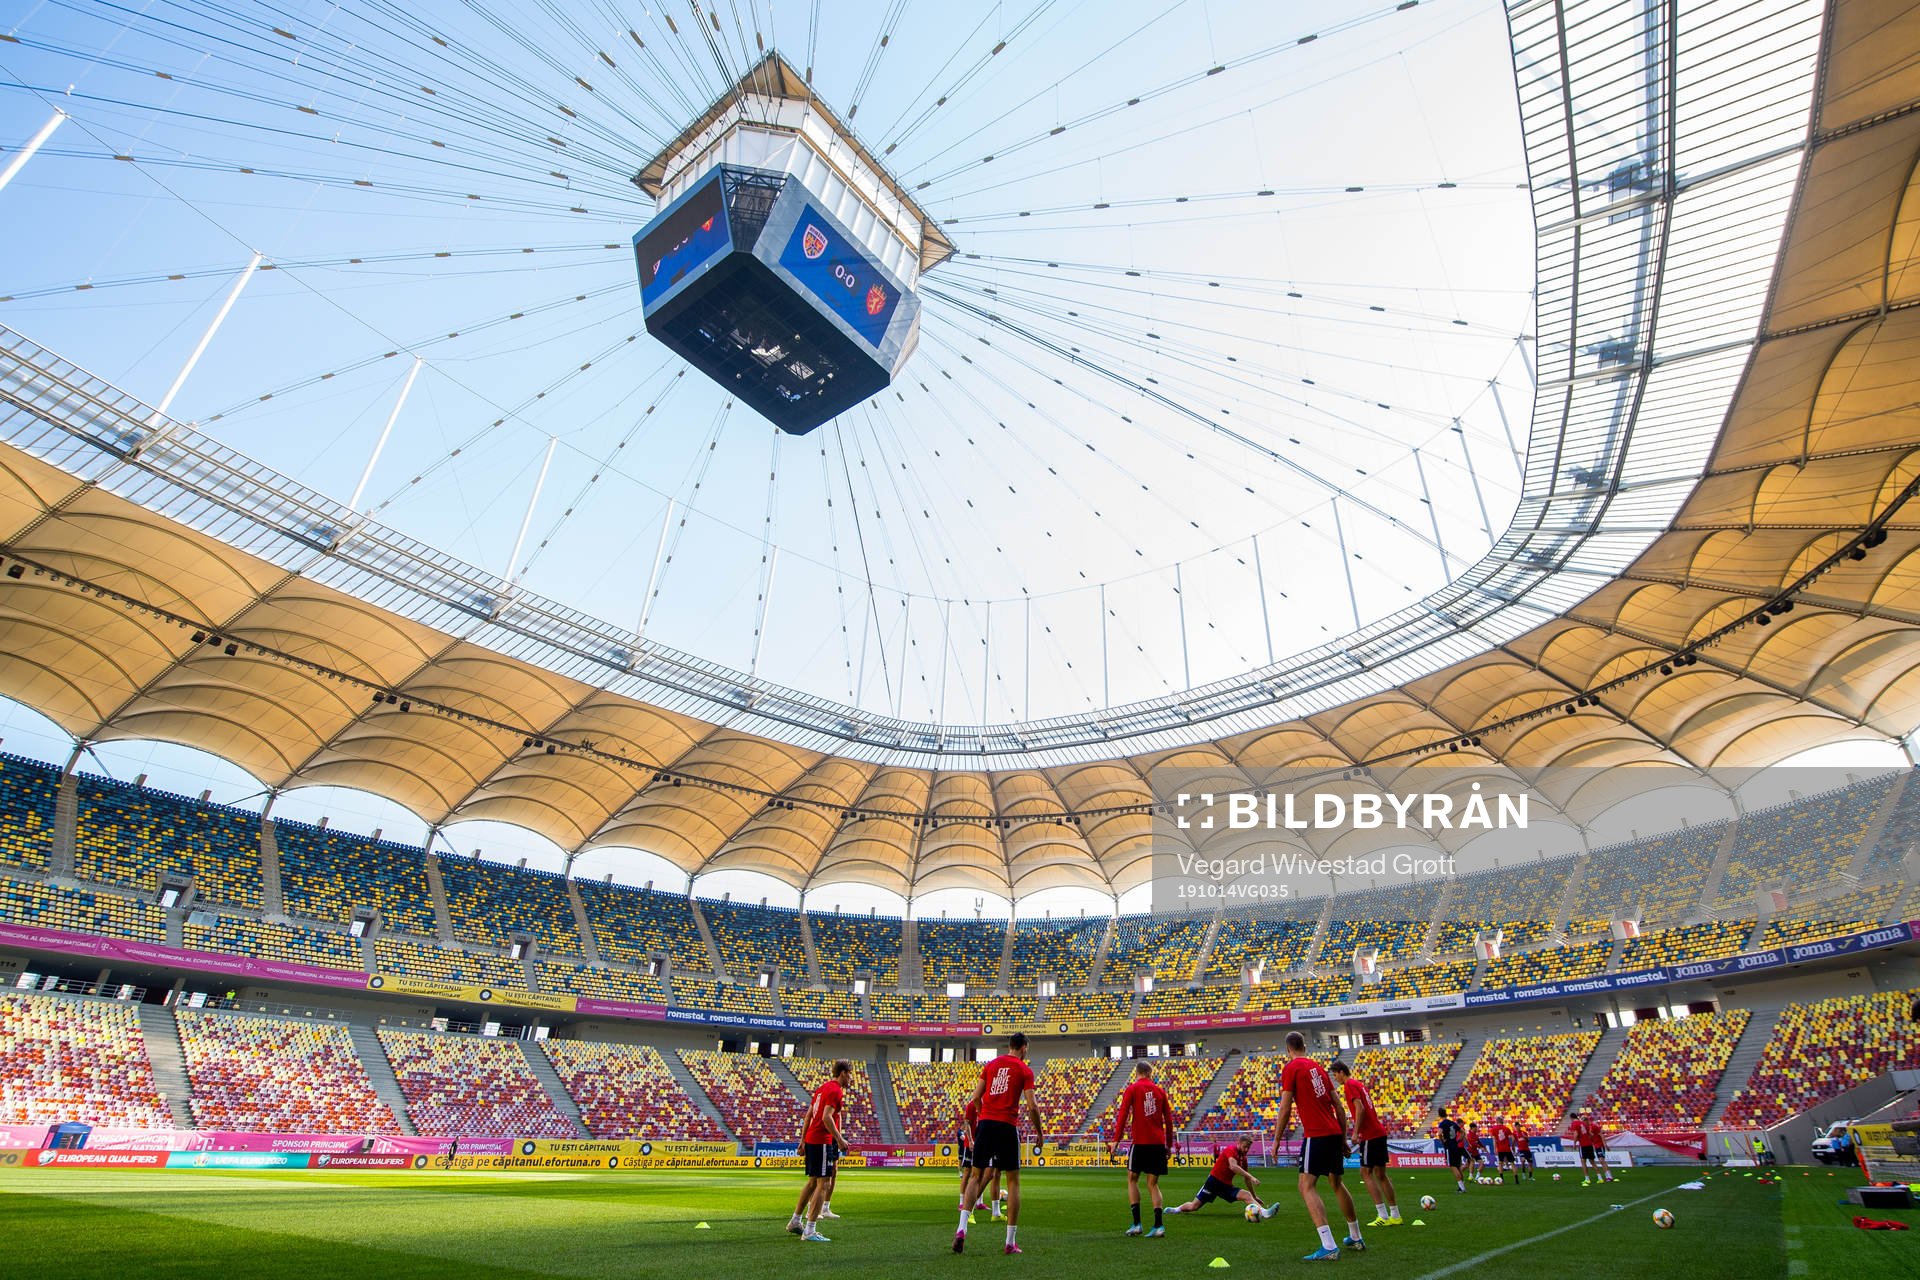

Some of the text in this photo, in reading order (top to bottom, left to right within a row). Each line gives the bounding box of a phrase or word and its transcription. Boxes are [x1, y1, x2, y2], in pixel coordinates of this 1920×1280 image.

[835, 265, 855, 288] 0:0
[272, 1139, 349, 1148] SPONSOR PRINCIPAL
[549, 1143, 560, 1151] TU
[57, 1154, 158, 1163] EUROPEAN QUALIFIERS
[476, 1159, 490, 1168] pe
[654, 1159, 664, 1168] pe
